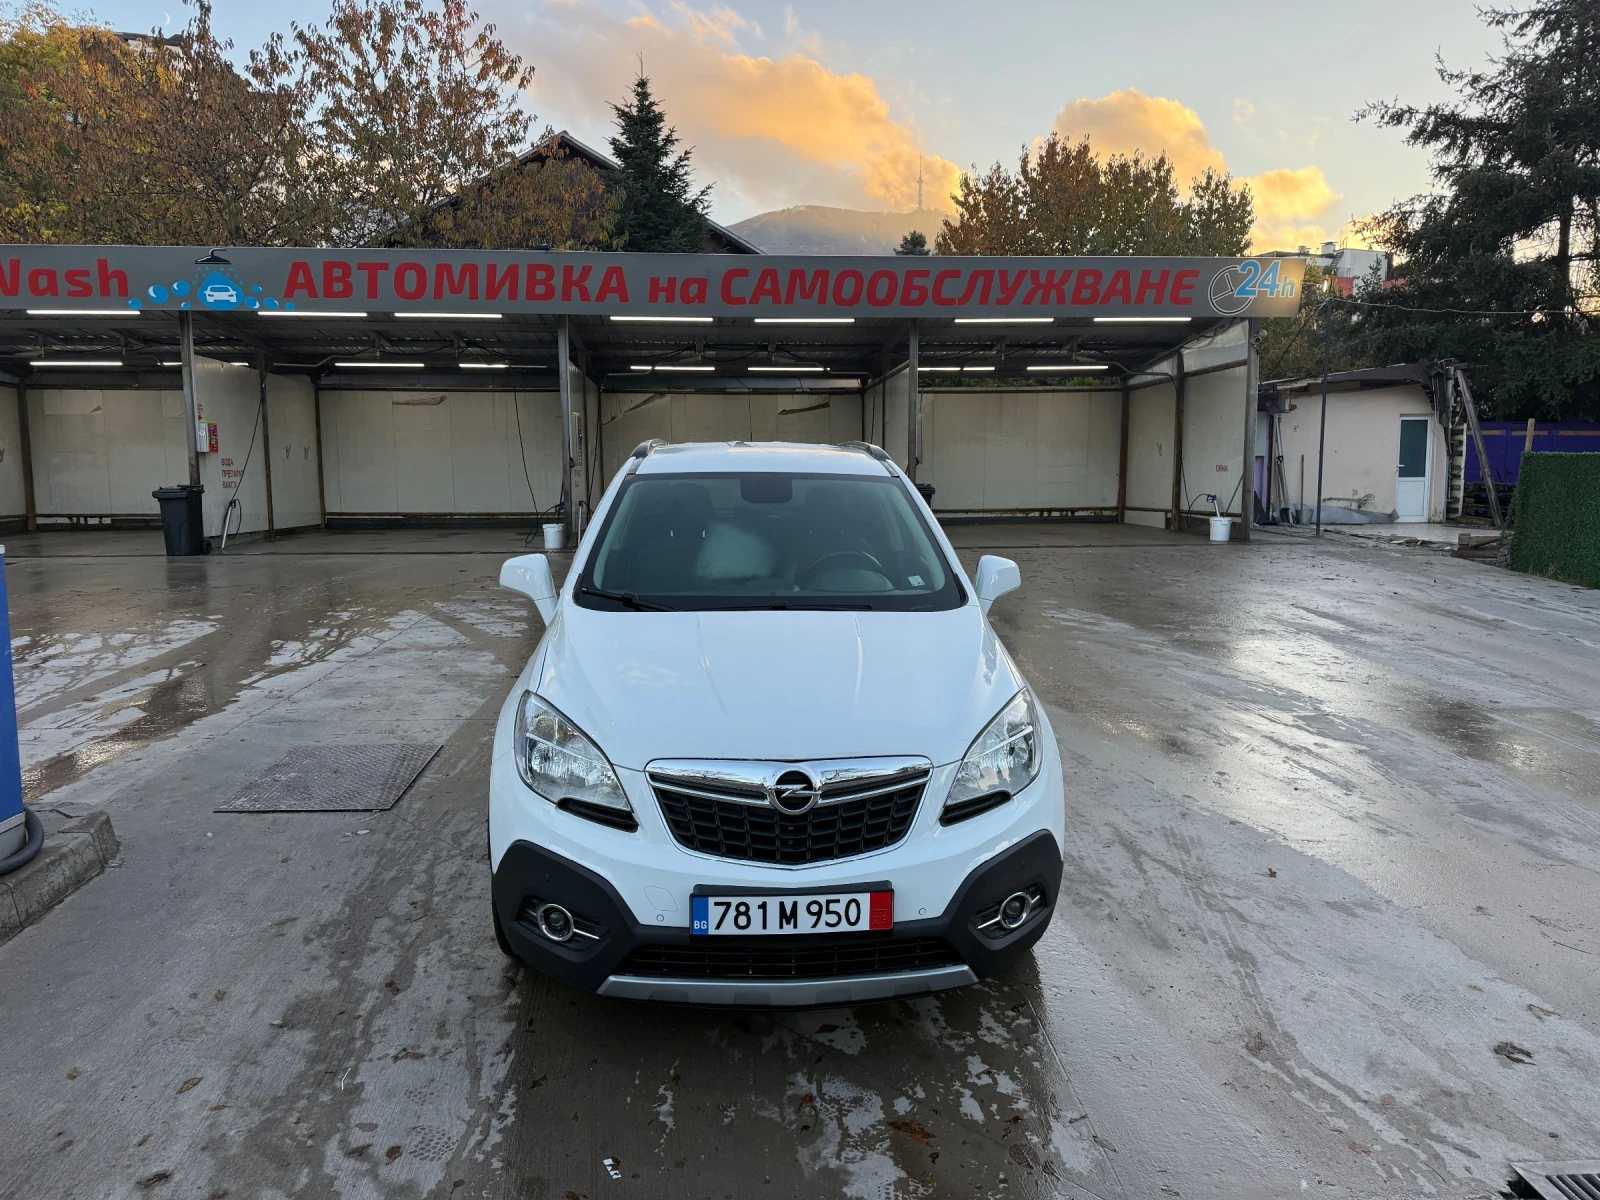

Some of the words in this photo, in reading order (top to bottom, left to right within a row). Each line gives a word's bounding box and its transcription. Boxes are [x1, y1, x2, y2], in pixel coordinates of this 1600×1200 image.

[283, 260, 630, 303] АВТОМИВКА
[648, 276, 708, 304] на
[720, 268, 1200, 307] САМООБСЛУЖВАНЕ
[1234, 260, 1295, 298] 24h
[693, 920, 708, 930] BG
[713, 901, 768, 930] 781
[778, 901, 798, 930] M
[805, 898, 861, 928] 950
